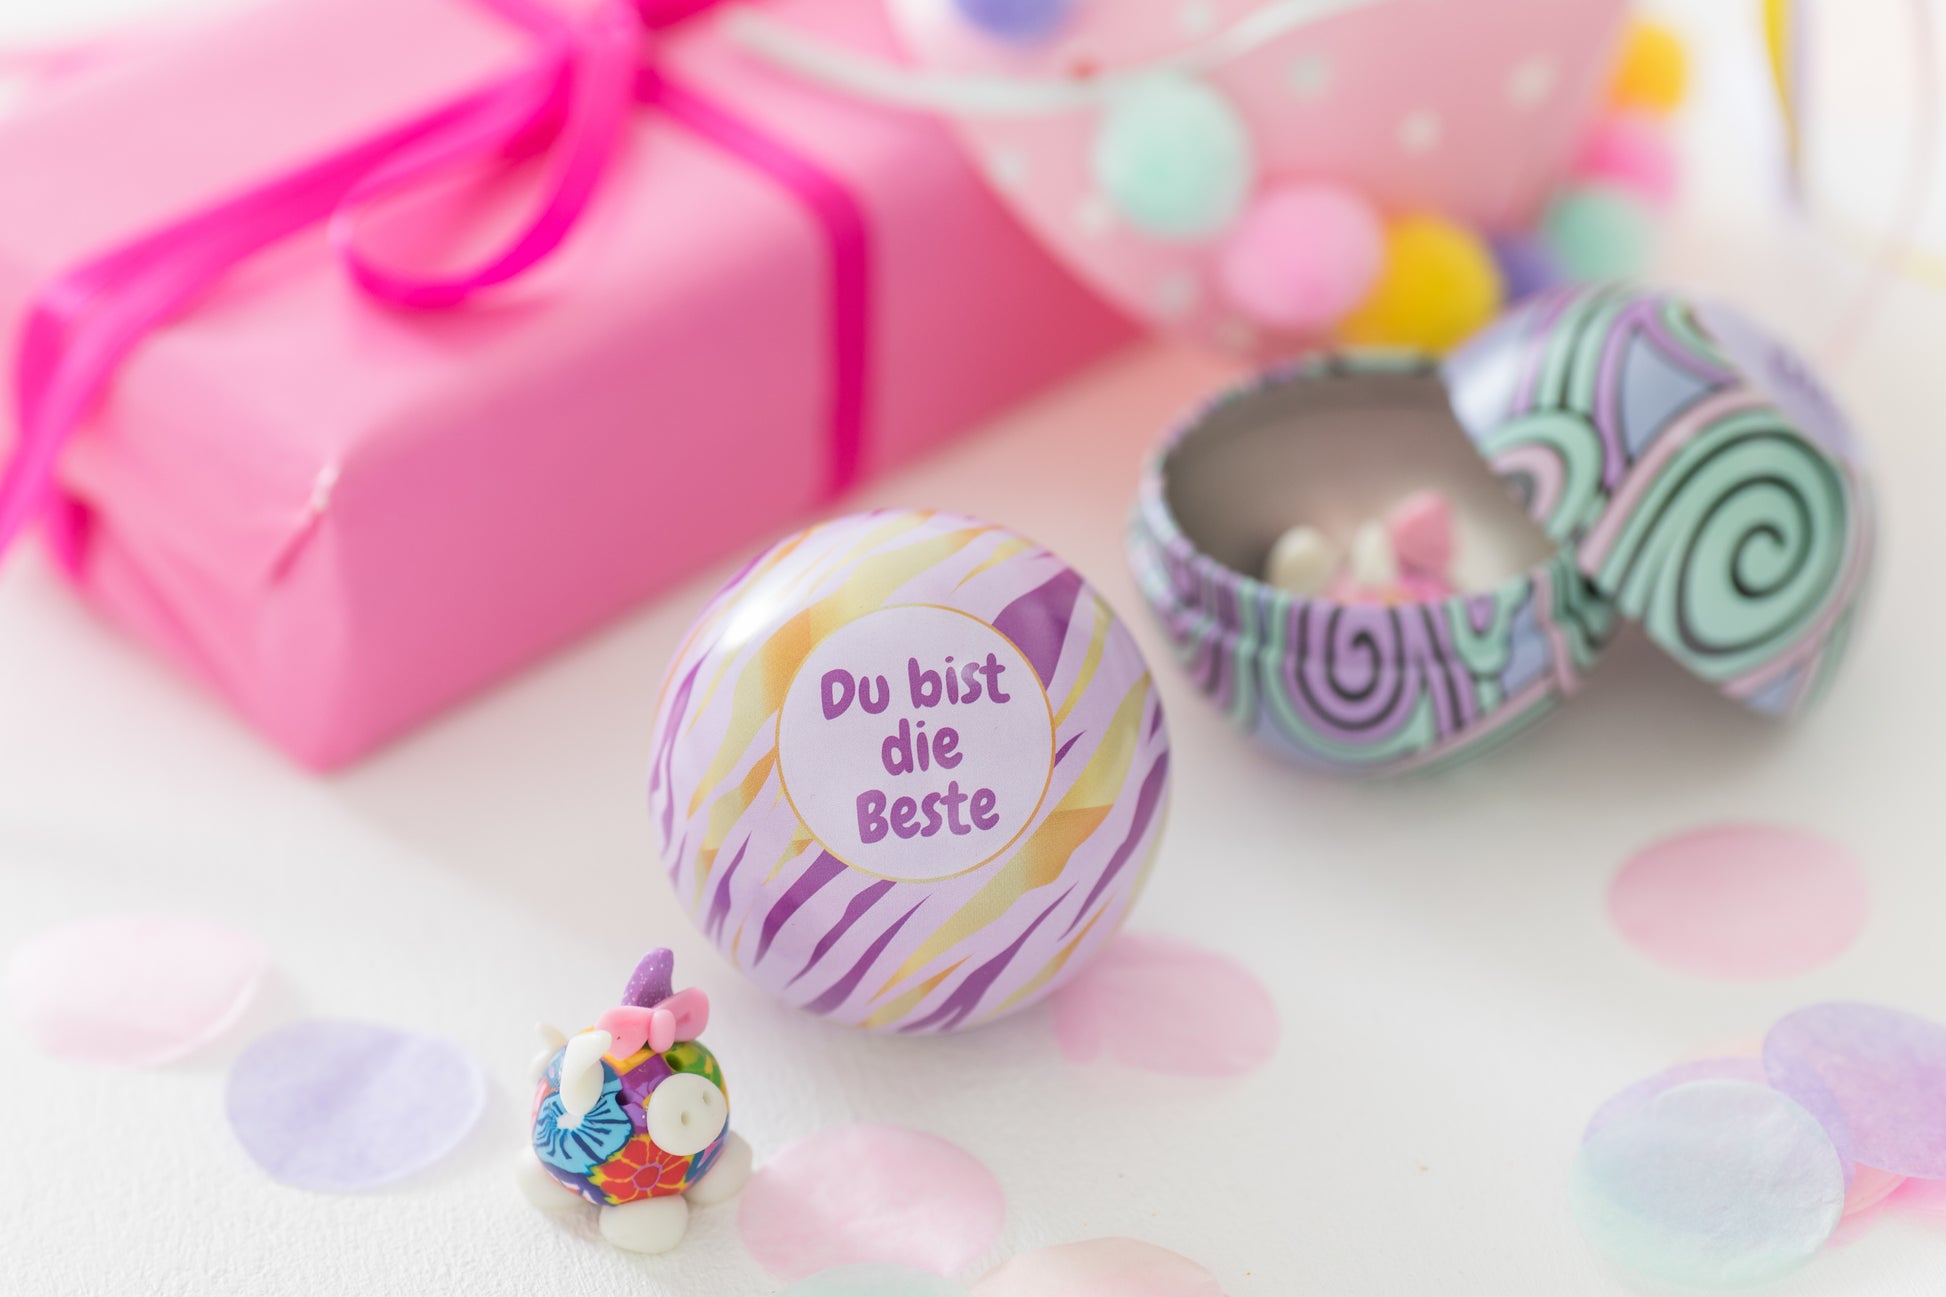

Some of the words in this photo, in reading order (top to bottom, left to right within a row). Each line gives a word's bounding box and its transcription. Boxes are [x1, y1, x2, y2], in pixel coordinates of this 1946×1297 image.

[820, 668, 890, 720] Du
[908, 652, 1010, 709] bist
[881, 718, 963, 776] die
[856, 780, 1000, 844] Beste
